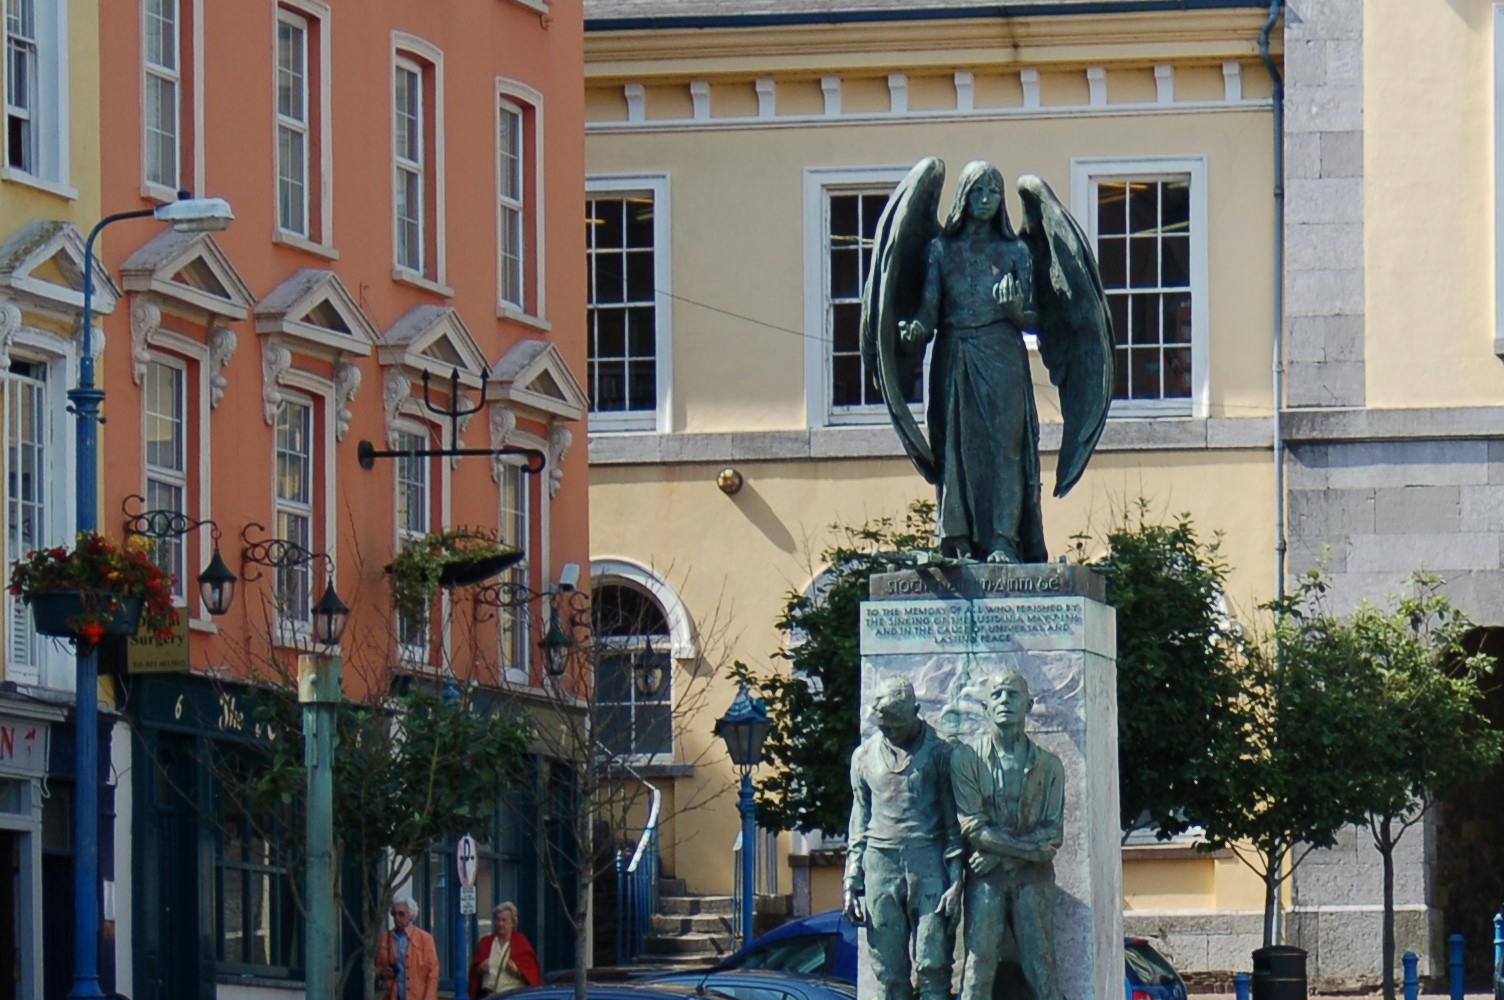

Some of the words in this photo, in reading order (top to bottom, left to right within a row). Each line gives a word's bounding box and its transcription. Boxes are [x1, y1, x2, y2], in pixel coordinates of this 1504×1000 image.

[866, 609, 880, 617] TO
[882, 608, 902, 616] THE
[904, 607, 946, 616] MEMORY
[866, 618, 884, 627] THE
[888, 617, 930, 625] SINKING
[981, 634, 1011, 642] PEACE
[175, 695, 185, 719] 6
